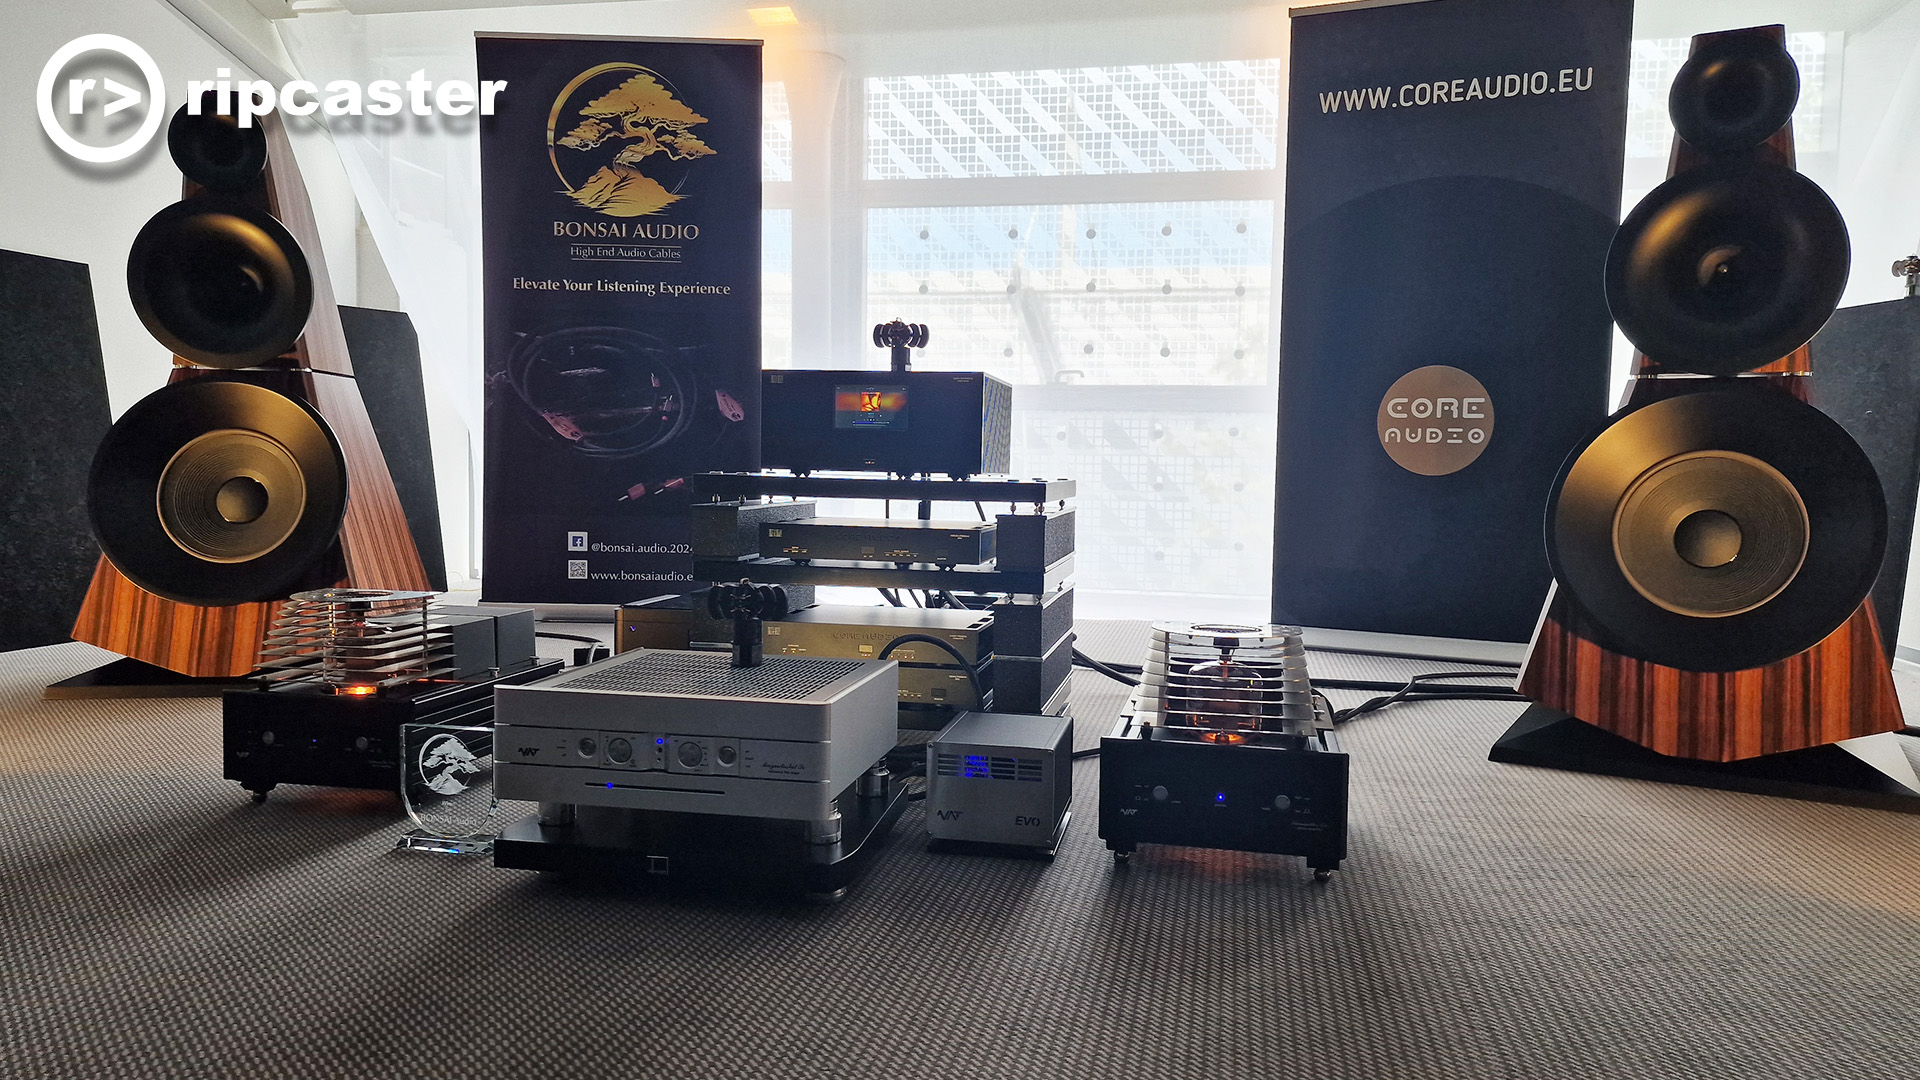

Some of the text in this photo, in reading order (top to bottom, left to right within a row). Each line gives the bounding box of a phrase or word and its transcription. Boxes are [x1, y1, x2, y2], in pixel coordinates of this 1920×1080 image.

[1319, 67, 1594, 114] WWW.COREAUDIO.EU
[553, 221, 700, 240] BONSAI AUDIO
[570, 246, 681, 259] High End Audio Cables
[513, 277, 731, 298] Elevate Your Listening Experience
[1387, 397, 1486, 419] CORE
[1384, 427, 1486, 444] AUDIO
[1015, 815, 1041, 827] EVO
